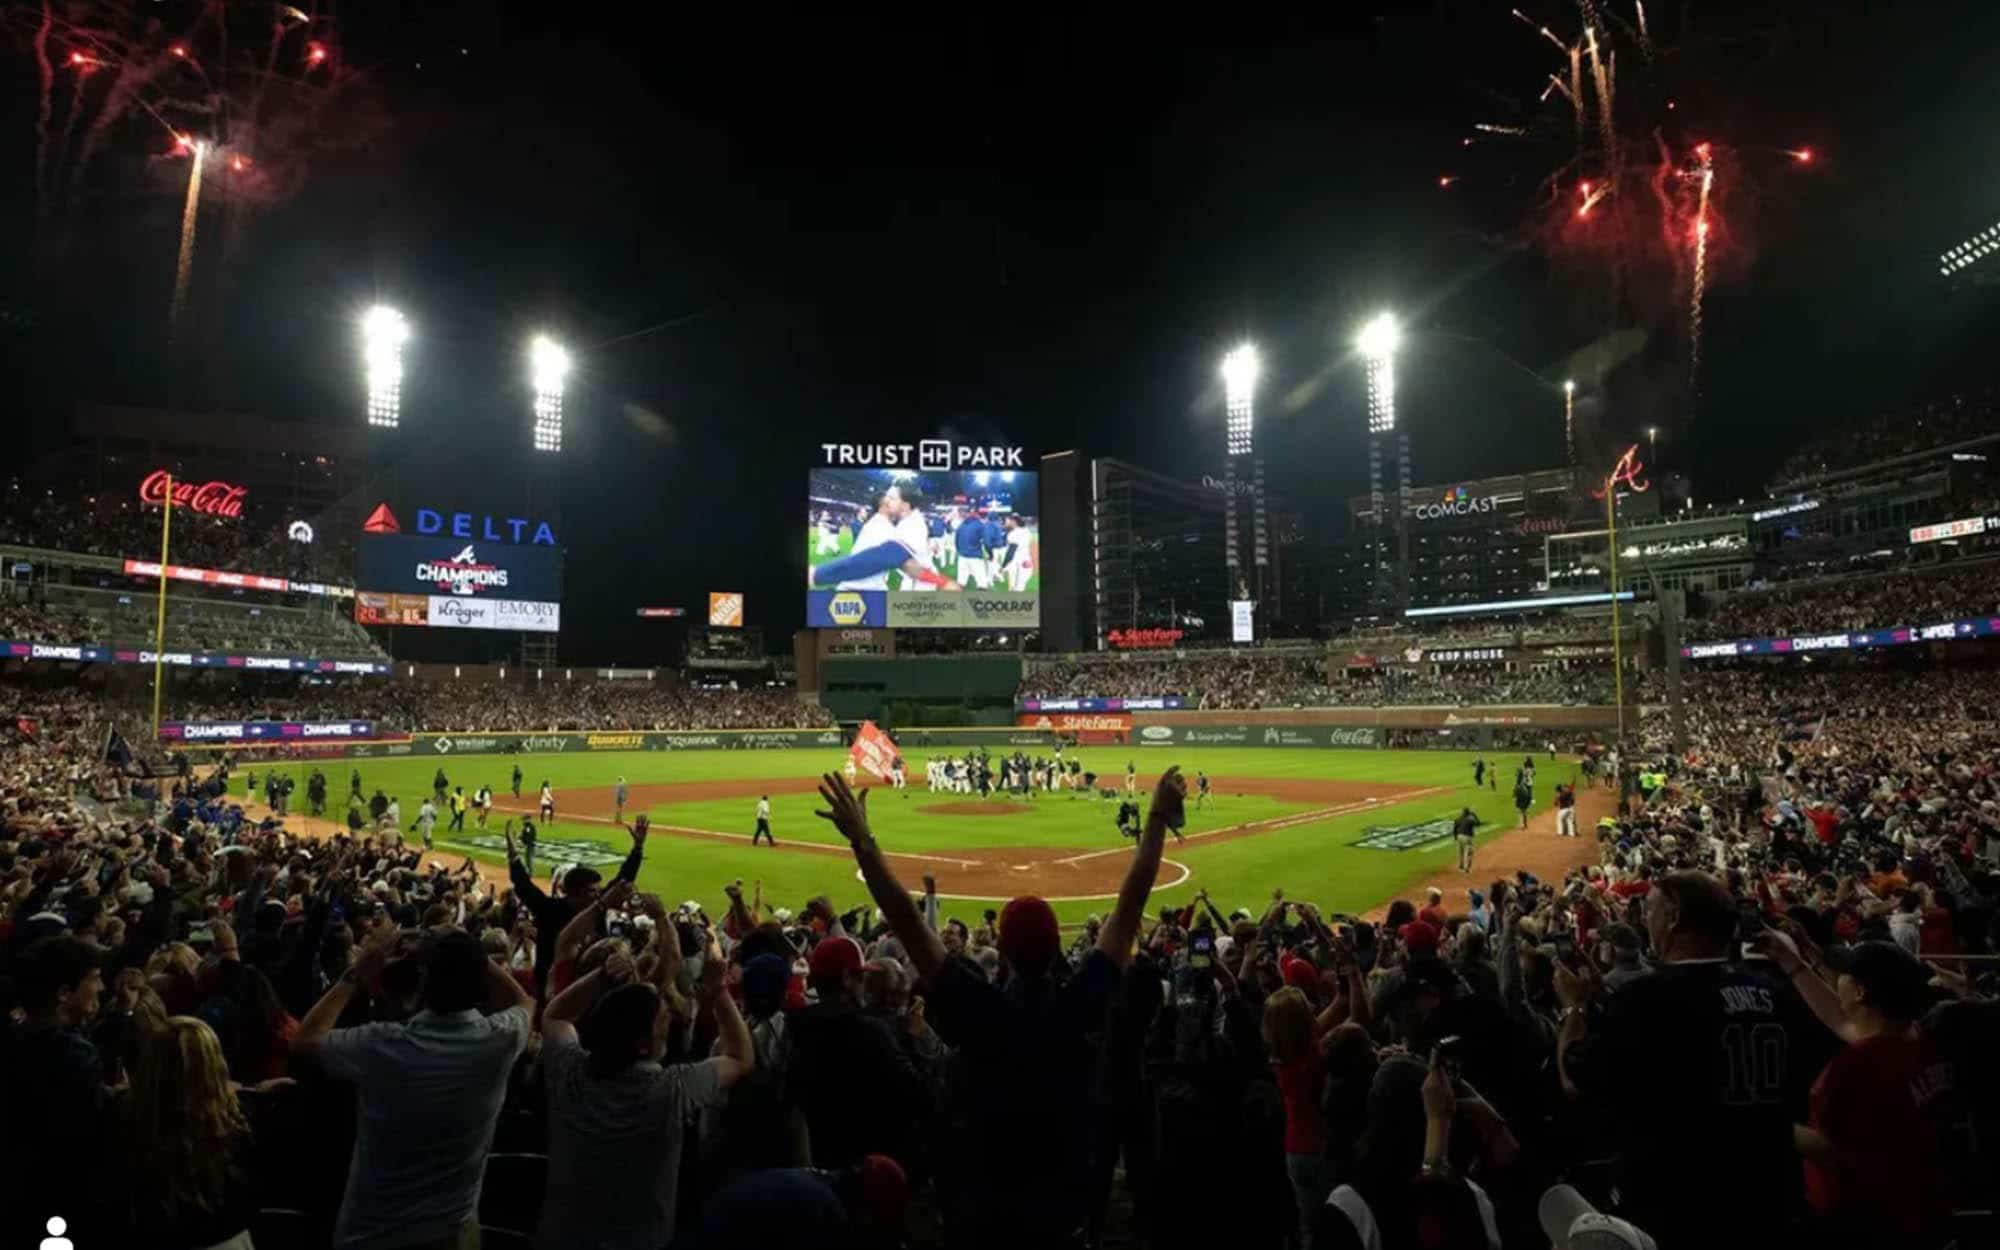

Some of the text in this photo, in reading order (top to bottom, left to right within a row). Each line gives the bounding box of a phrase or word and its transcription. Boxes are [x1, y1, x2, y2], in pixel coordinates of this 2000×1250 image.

[822, 444, 1023, 467] TRUIST PARK
[140, 470, 248, 517] Coca-Cola
[1416, 496, 1499, 520] COMCAST
[416, 508, 555, 545] DELTA
[416, 563, 508, 587] CHAMPIONS
[437, 600, 485, 625] Kroger
[500, 602, 555, 616] EMORY
[834, 601, 862, 616] NAPA
[973, 600, 1034, 612] COOLRAY
[1720, 1023, 1789, 1104] 10
